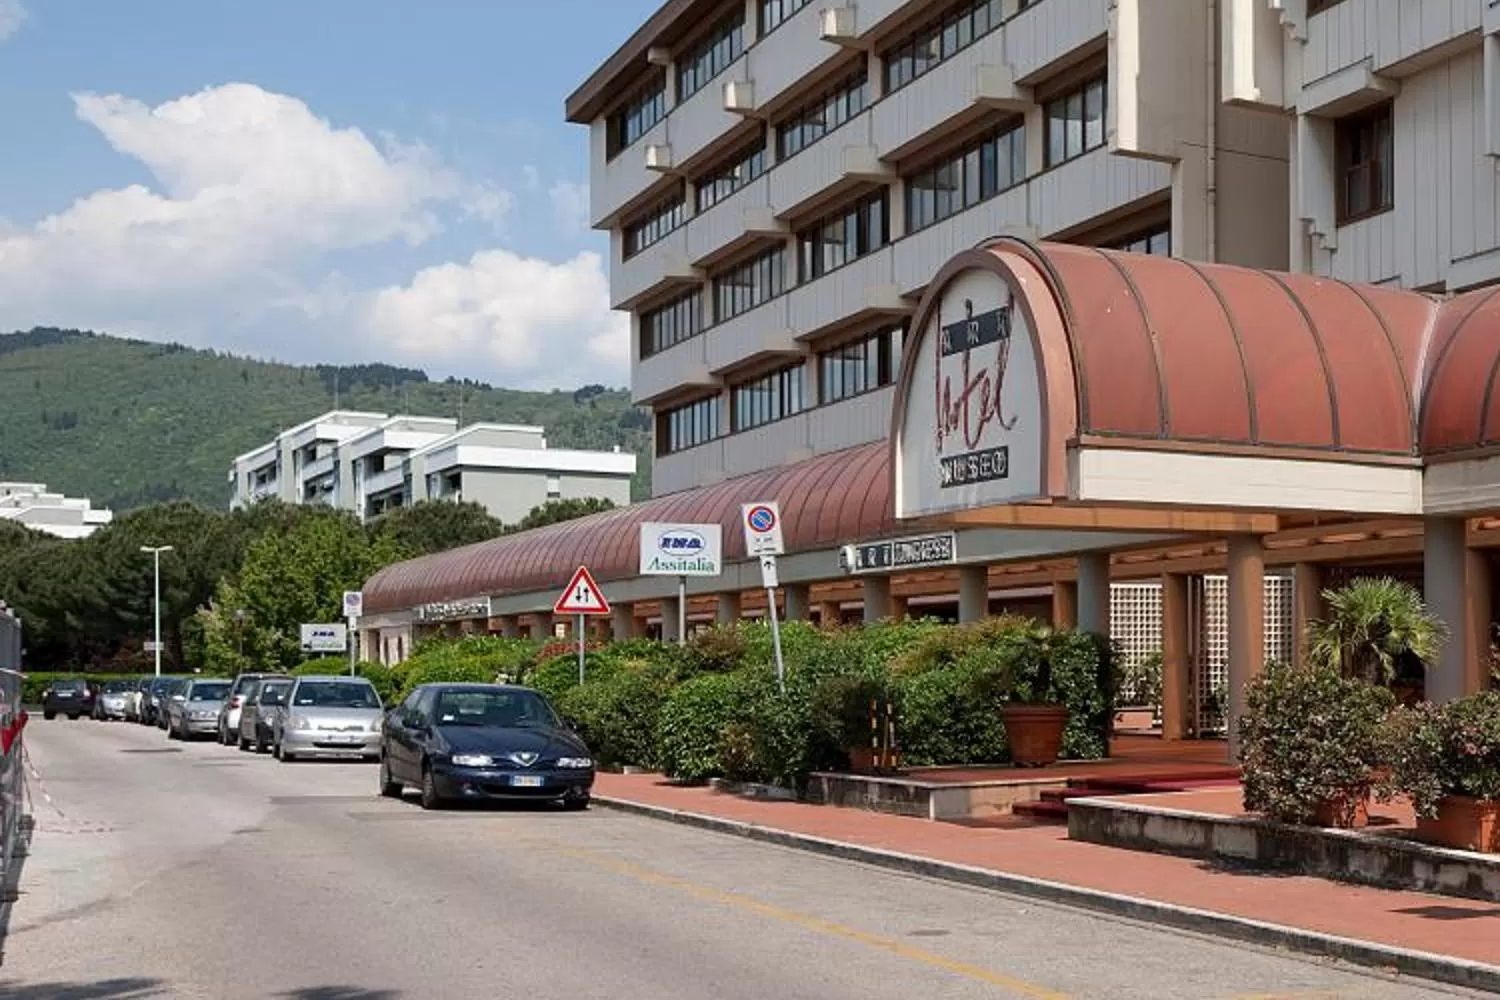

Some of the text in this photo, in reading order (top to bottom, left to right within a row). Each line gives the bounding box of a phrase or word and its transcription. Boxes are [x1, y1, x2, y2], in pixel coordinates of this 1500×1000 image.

[939, 450, 1006, 484] MUSEO
[661, 537, 701, 549] INA
[647, 556, 715, 573] Assitalia
